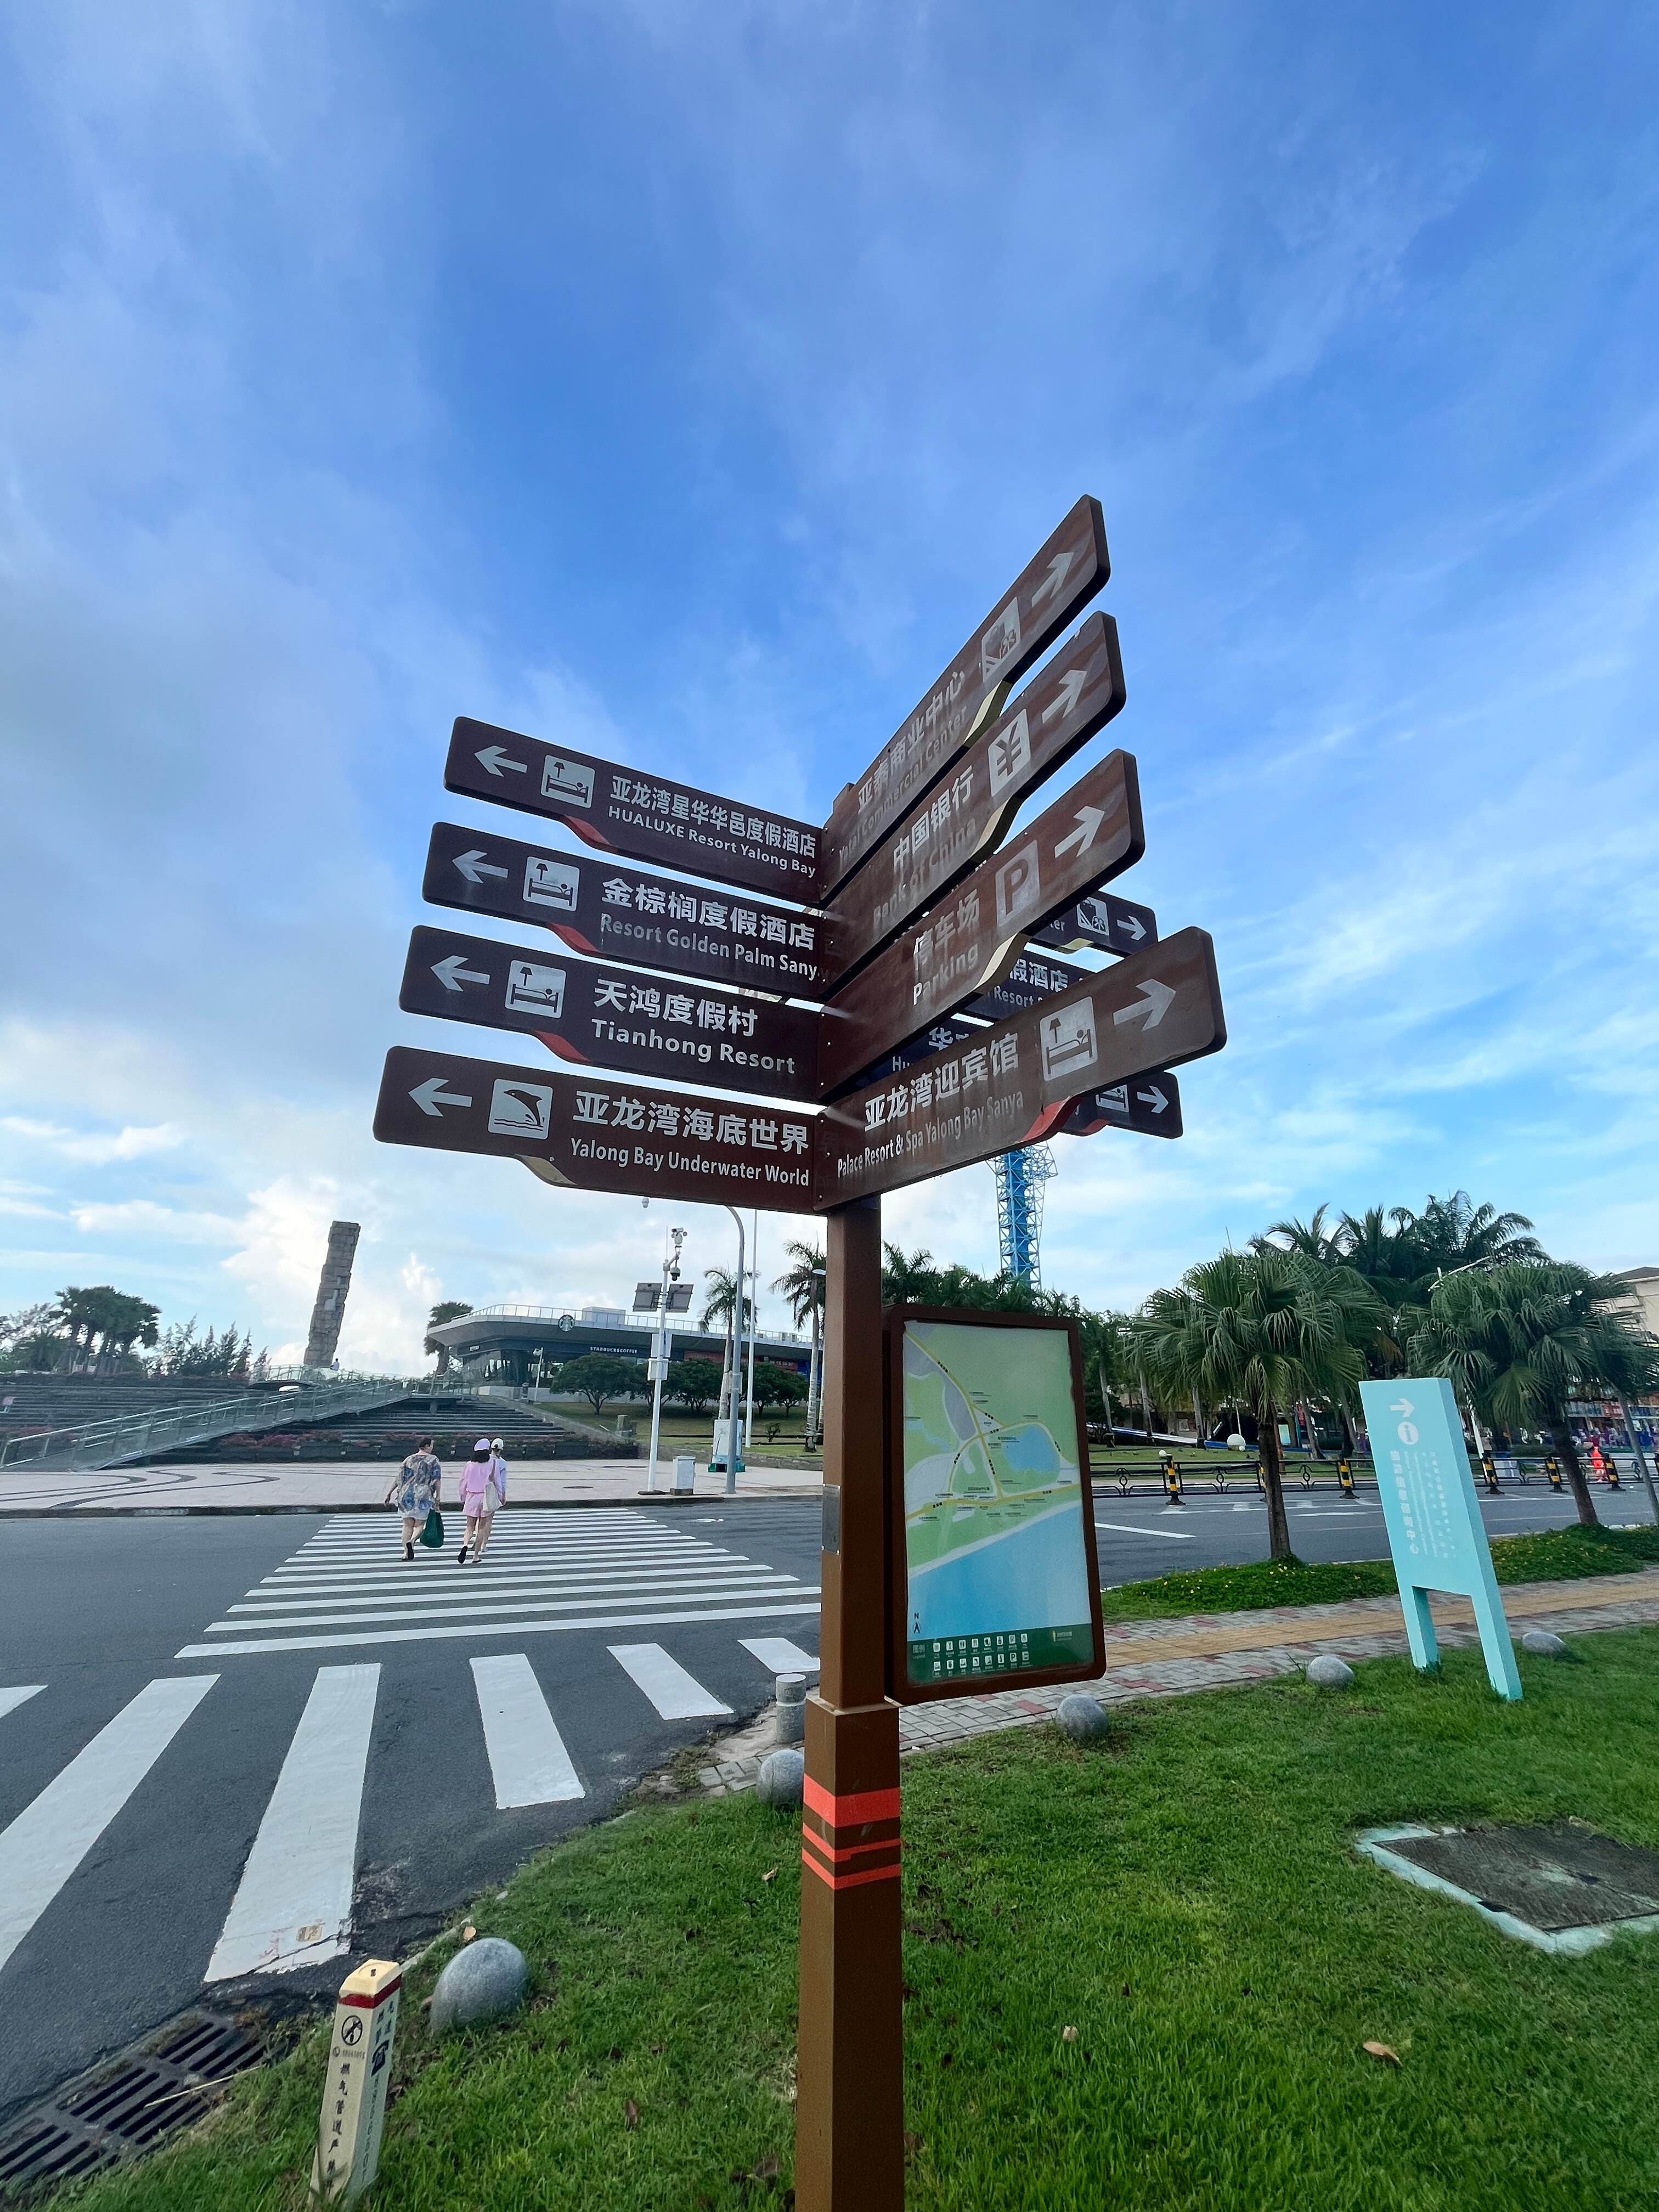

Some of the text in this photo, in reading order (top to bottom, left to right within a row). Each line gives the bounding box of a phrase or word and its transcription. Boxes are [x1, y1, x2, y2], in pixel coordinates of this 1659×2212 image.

[858, 671, 966, 814] 亚泰商业中心
[926, 706, 967, 763] Center
[608, 806, 816, 878] HUALUXE Resort Yalong Bay
[610, 775, 816, 859] 亚龙湾星华华邑度假酒店
[893, 765, 974, 868] 中国银行
[929, 817, 976, 868] China
[601, 877, 815, 951] 金棕榈度假酒店
[601, 913, 662, 943] Resort
[667, 929, 730, 958] Golden
[735, 944, 775, 968] Palm
[913, 888, 980, 971] 停车场
[913, 943, 978, 1006] Parking
[994, 985, 1034, 1007] Resort
[594, 978, 758, 1037] 天鸿度假村
[591, 1018, 795, 1074] Tianhong Resort
[865, 1032, 1019, 1132] 亚龙湾迎宾馆
[572, 1091, 809, 1155] 亚龙湾海底世界
[837, 1091, 1024, 1178] Palace Resort & Spa Yalong Bay Sanya
[571, 1138, 809, 1186] Yalong Bay Underwater World
